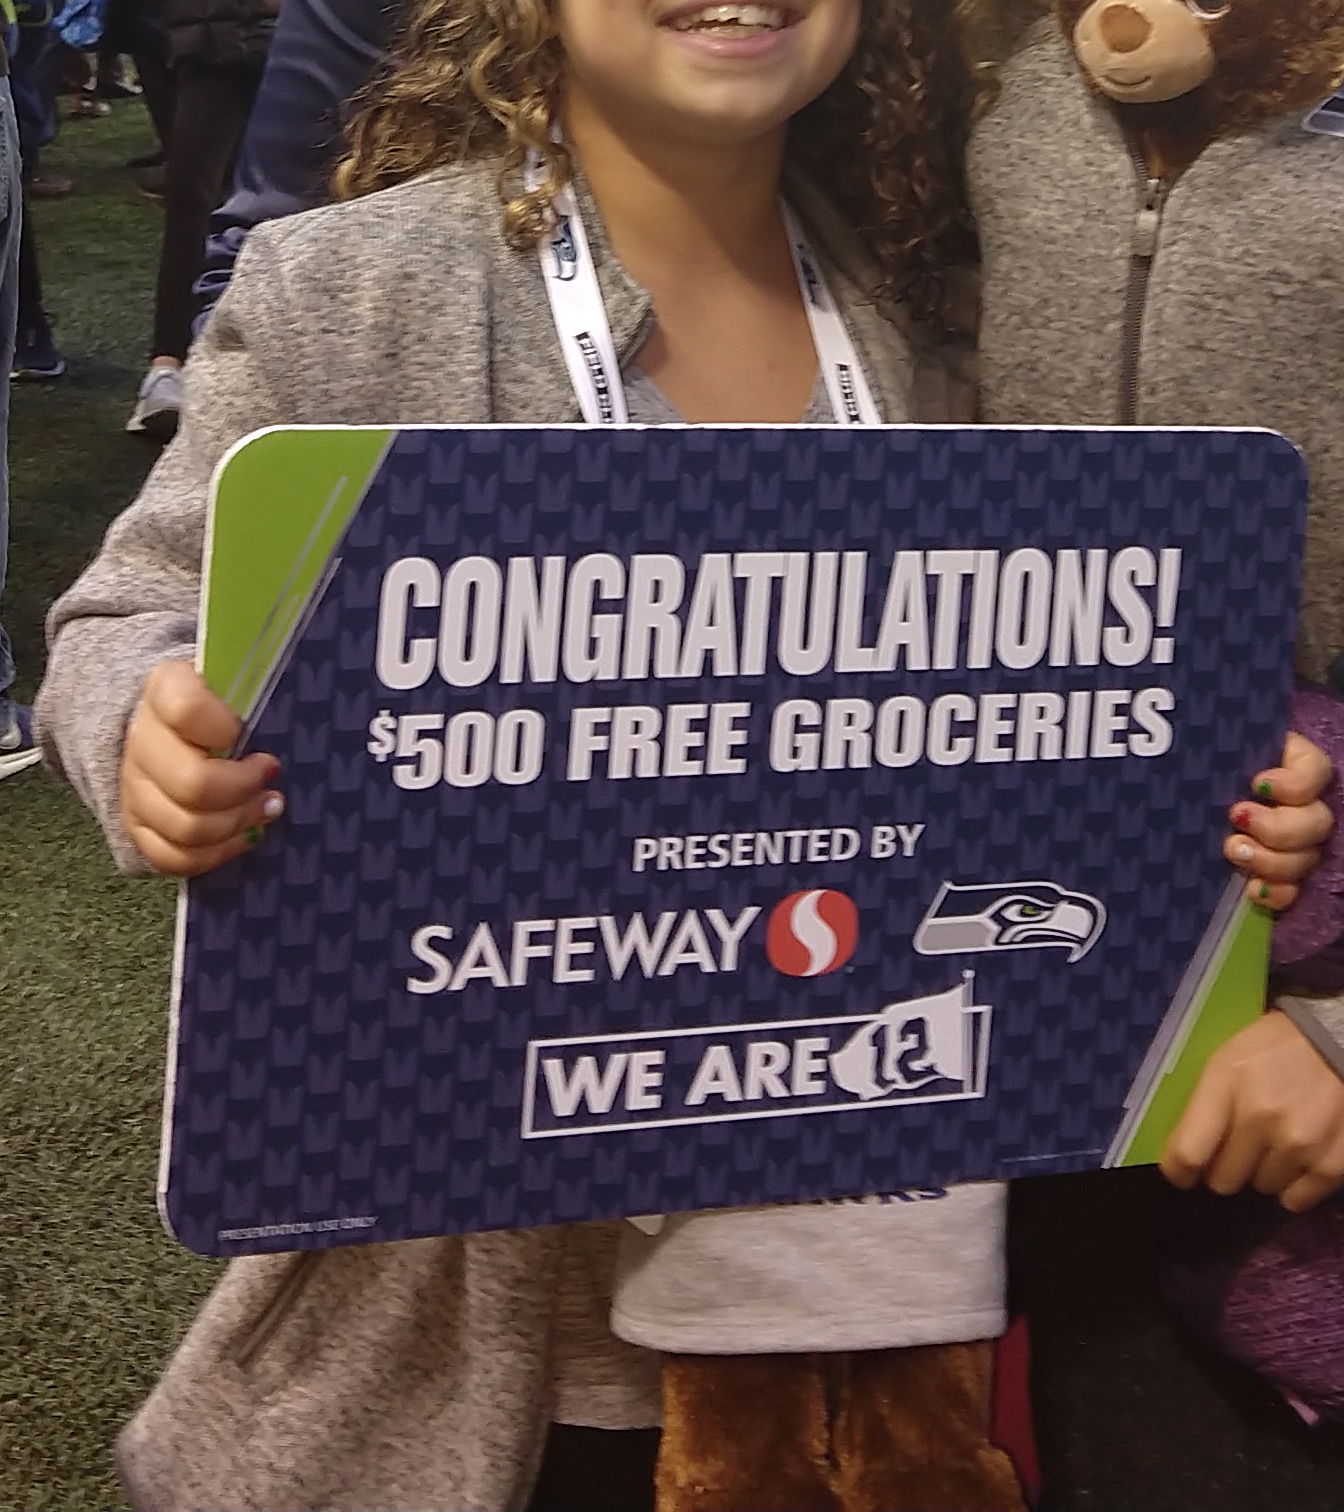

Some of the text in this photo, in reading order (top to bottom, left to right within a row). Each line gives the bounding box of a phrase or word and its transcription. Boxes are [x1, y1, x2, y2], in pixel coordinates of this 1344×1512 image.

[374, 546, 1183, 690] CONGRATULATIONS!
[366, 687, 1176, 791] $500 FREE GROCERIES
[631, 822, 926, 874] PRESENTED BY
[405, 905, 763, 994] SAFEWAY
[542, 1049, 667, 1118] WE
[684, 1036, 833, 1107] ARE
